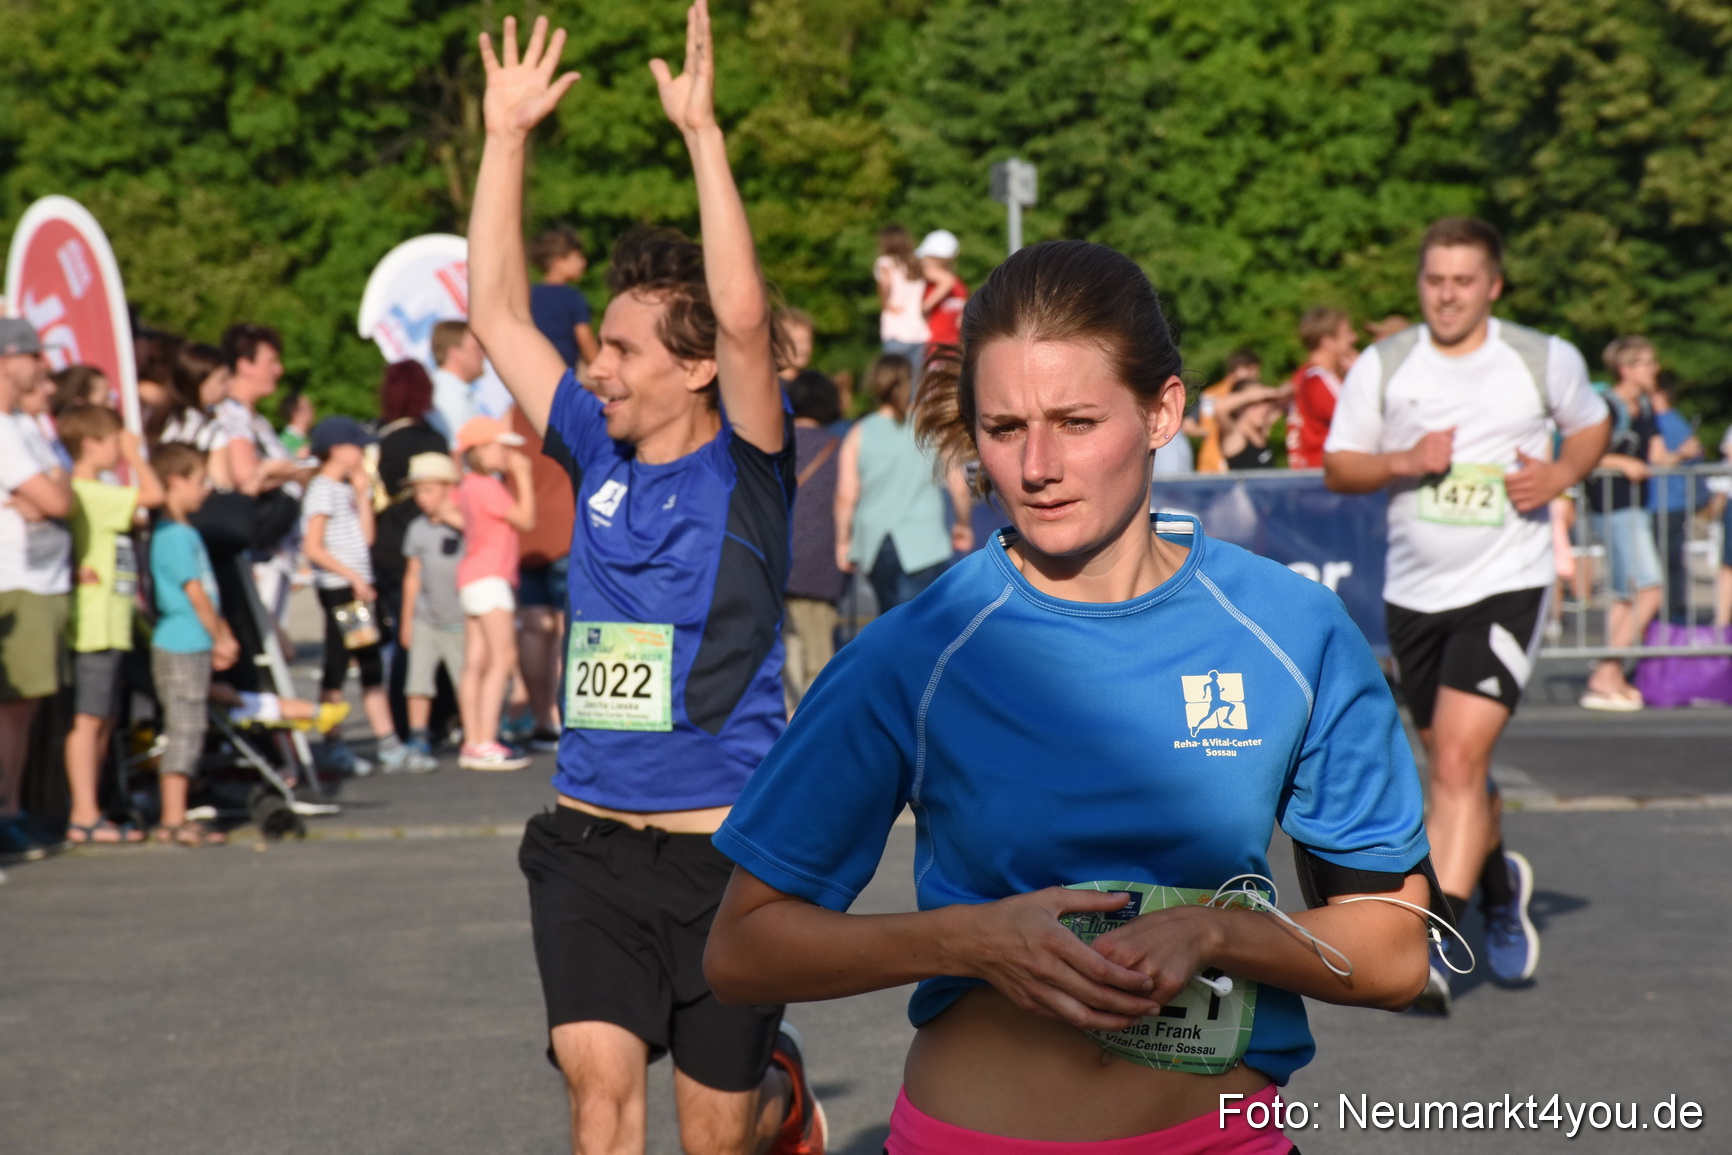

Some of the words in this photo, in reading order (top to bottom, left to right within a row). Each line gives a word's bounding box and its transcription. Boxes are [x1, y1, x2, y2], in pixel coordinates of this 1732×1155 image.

[1430, 485, 1495, 508] 1472
[576, 661, 652, 698] 2022
[1174, 739, 1200, 749] Reha-
[1205, 748, 1237, 757] Sossau
[1155, 1021, 1202, 1040] Frank
[1106, 1033, 1174, 1052] Vital-Center
[1176, 1042, 1216, 1055] Sossau
